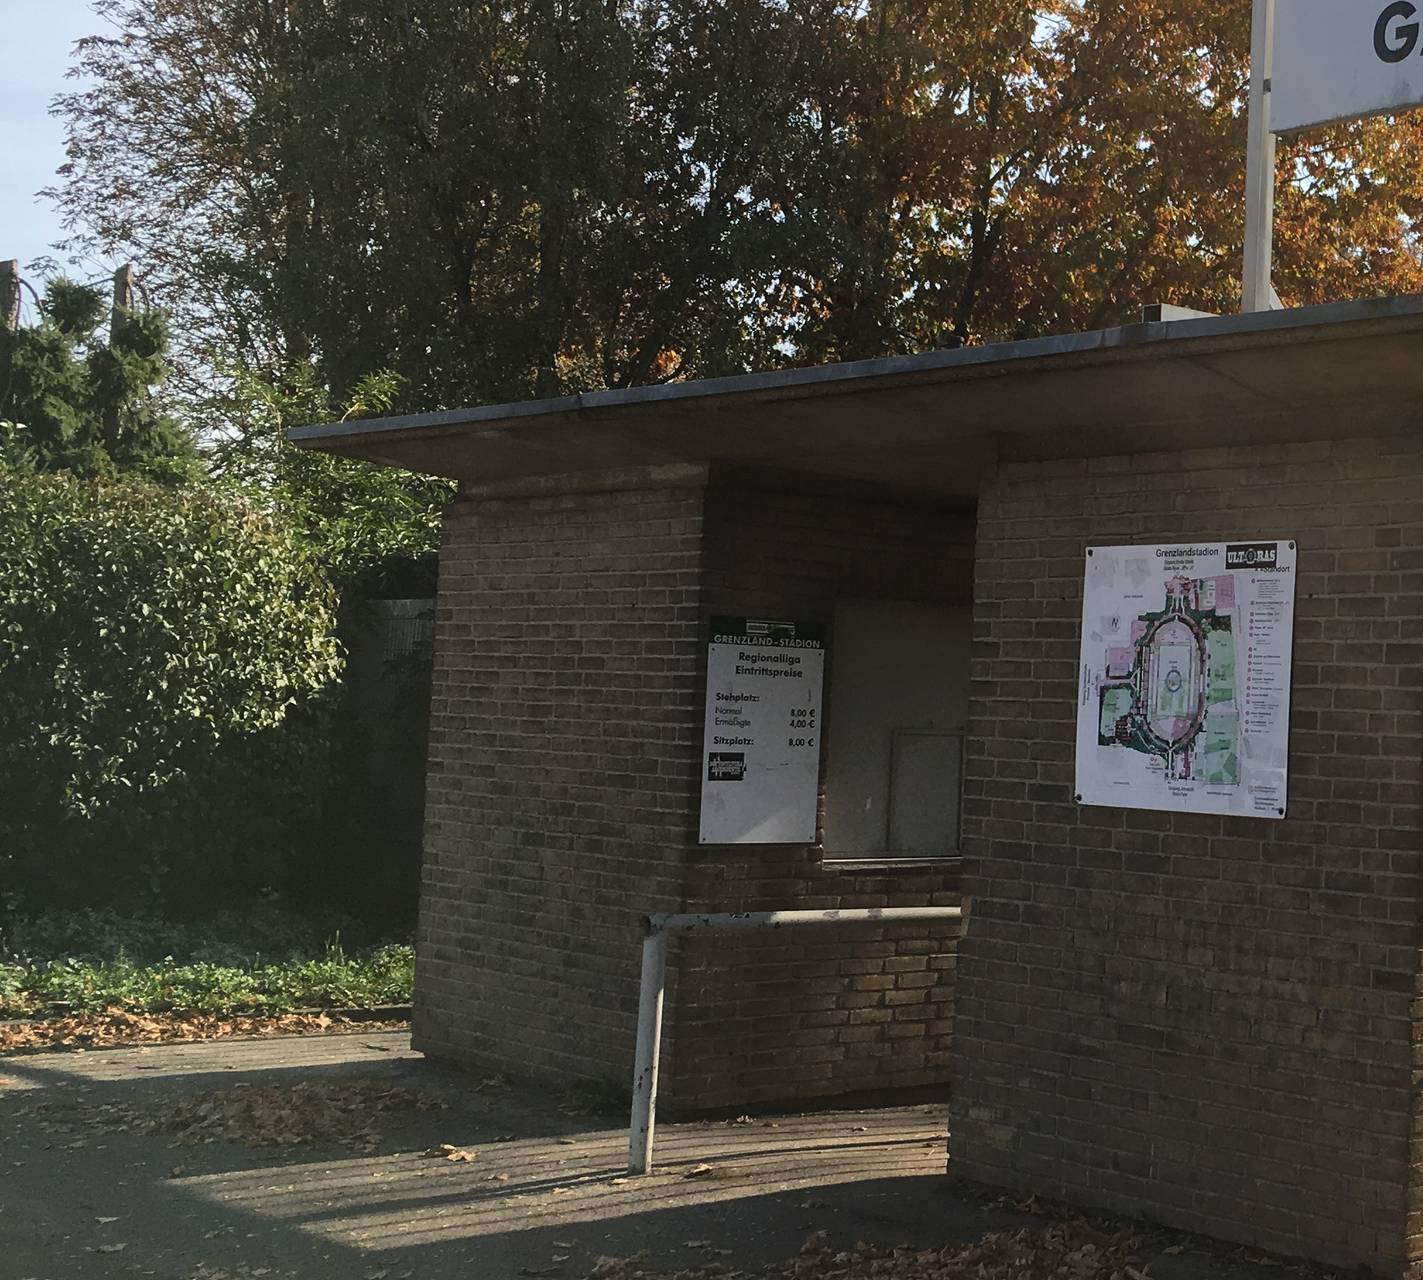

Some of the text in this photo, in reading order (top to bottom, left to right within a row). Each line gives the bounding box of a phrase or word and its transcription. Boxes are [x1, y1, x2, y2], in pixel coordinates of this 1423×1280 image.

[1156, 548, 1219, 558] Grenzlandstadion
[738, 652, 801, 665] Regionalliga
[736, 666, 803, 678] Eintrittspreise
[716, 692, 760, 702] Stehplatz:
[715, 706, 816, 717] Normal 8,00 €
[790, 720, 807, 728] 4,00
[808, 720, 815, 728] €
[714, 736, 814, 747] Sitzplatz: 8,00 €
